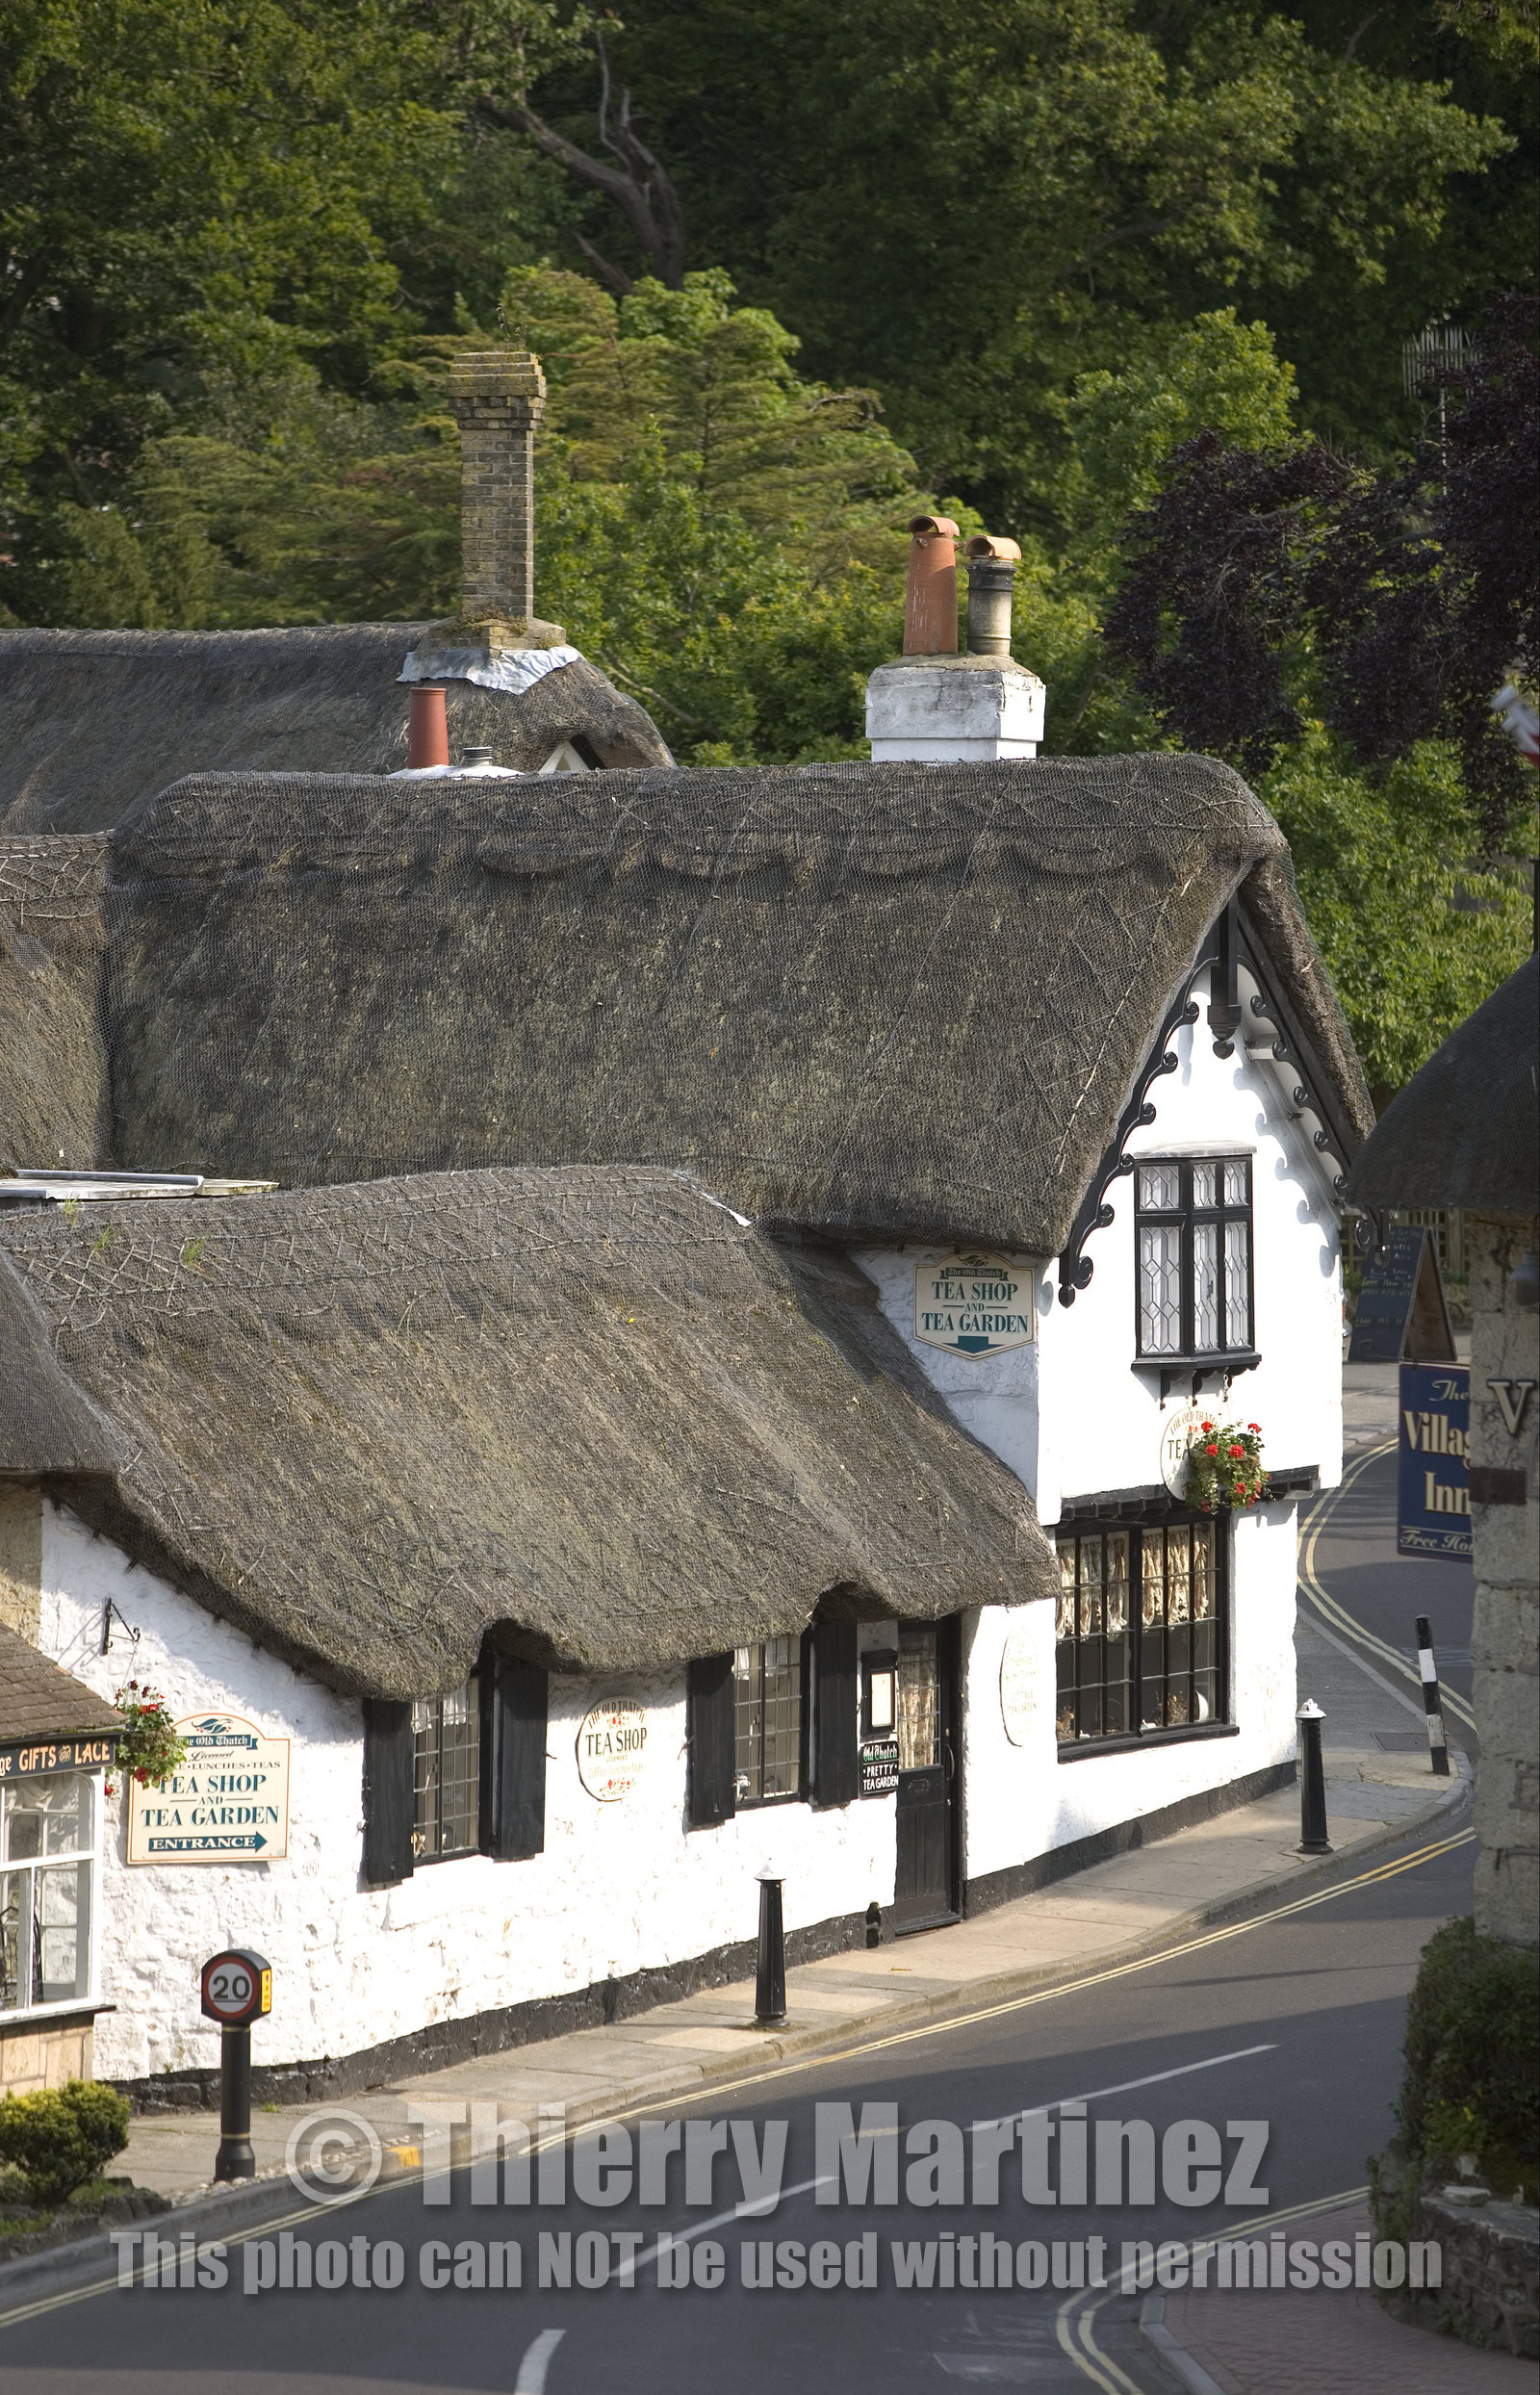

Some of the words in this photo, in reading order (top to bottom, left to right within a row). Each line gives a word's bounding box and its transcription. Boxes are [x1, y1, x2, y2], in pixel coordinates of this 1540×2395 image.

[977, 1269, 1001, 1277] Thatch
[932, 1281, 965, 1300] TEA
[971, 1282, 1018, 1301] SHOP
[964, 1302, 985, 1312] AND
[921, 1312, 955, 1331] TEA
[959, 1313, 1029, 1333] GARDEN
[1428, 1379, 1470, 1403] The
[1182, 1411, 1194, 1425] OLD
[1168, 1439, 1191, 1460] TEA
[1424, 1471, 1472, 1516] Inn
[1400, 1530, 1438, 1548] Free
[603, 1701, 616, 1715] OLD
[617, 1700, 646, 1724] THATCH
[195, 1737, 214, 1746] Old
[216, 1736, 248, 1746] Thatch
[585, 1733, 612, 1757] TEA
[616, 1727, 648, 1752] SHOP
[18, 1745, 57, 1771] GIFTS
[74, 1740, 110, 1764] LACE
[189, 1750, 235, 1763] Licensed
[862, 1745, 874, 1762] Old
[192, 1762, 245, 1770] LUNCHES
[251, 1761, 280, 1769] TEAS
[866, 1764, 894, 1778] PRETTY
[159, 1775, 199, 1794] TEA
[207, 1774, 267, 1793] SHOP
[862, 1779, 876, 1790] TEA
[876, 1775, 899, 1789] GARDEN
[198, 1796, 223, 1806] AND
[141, 1809, 183, 1827] TEA
[191, 1806, 279, 1826] GARDEN
[152, 1837, 256, 1850] ENTRANCE
[213, 1975, 250, 1999] 20
